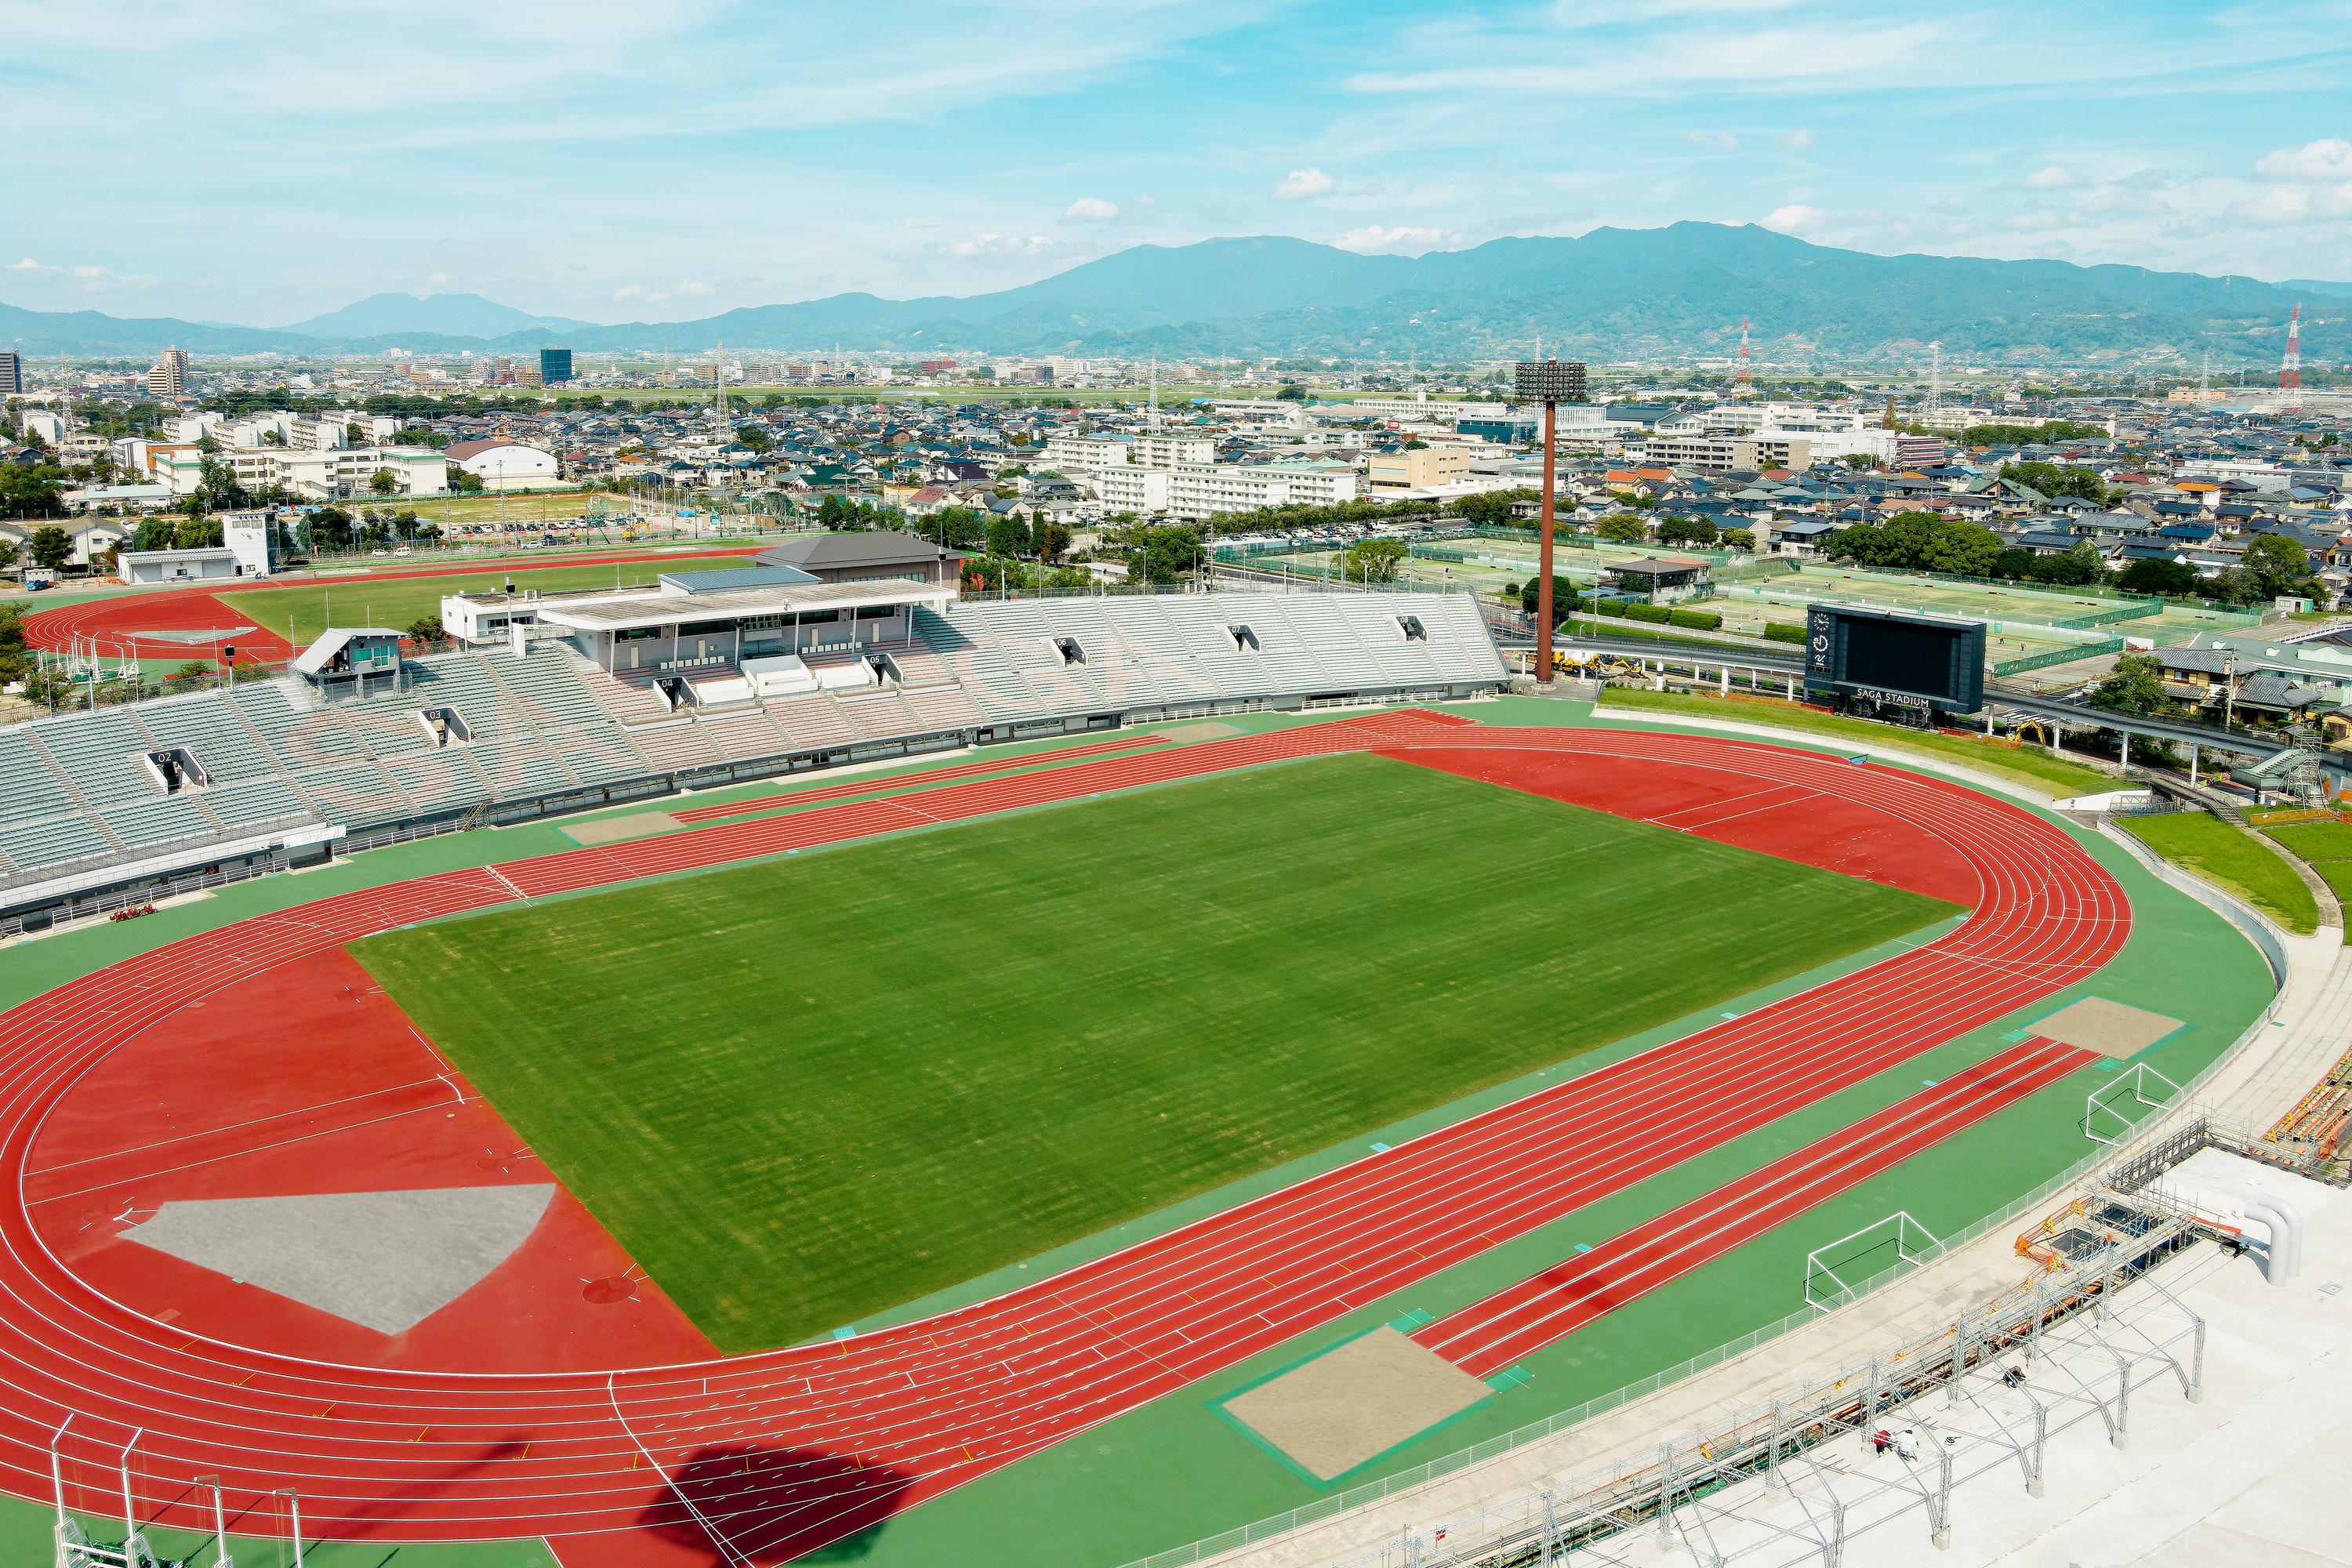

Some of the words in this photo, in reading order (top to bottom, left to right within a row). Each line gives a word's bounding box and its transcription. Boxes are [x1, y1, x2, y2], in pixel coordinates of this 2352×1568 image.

[869, 655, 880, 664] 05
[662, 679, 673, 688] 04
[1857, 688, 1882, 699] SAGA
[1886, 693, 1929, 708] STADIUM
[430, 710, 441, 719] 03
[158, 753, 172, 762] 02
